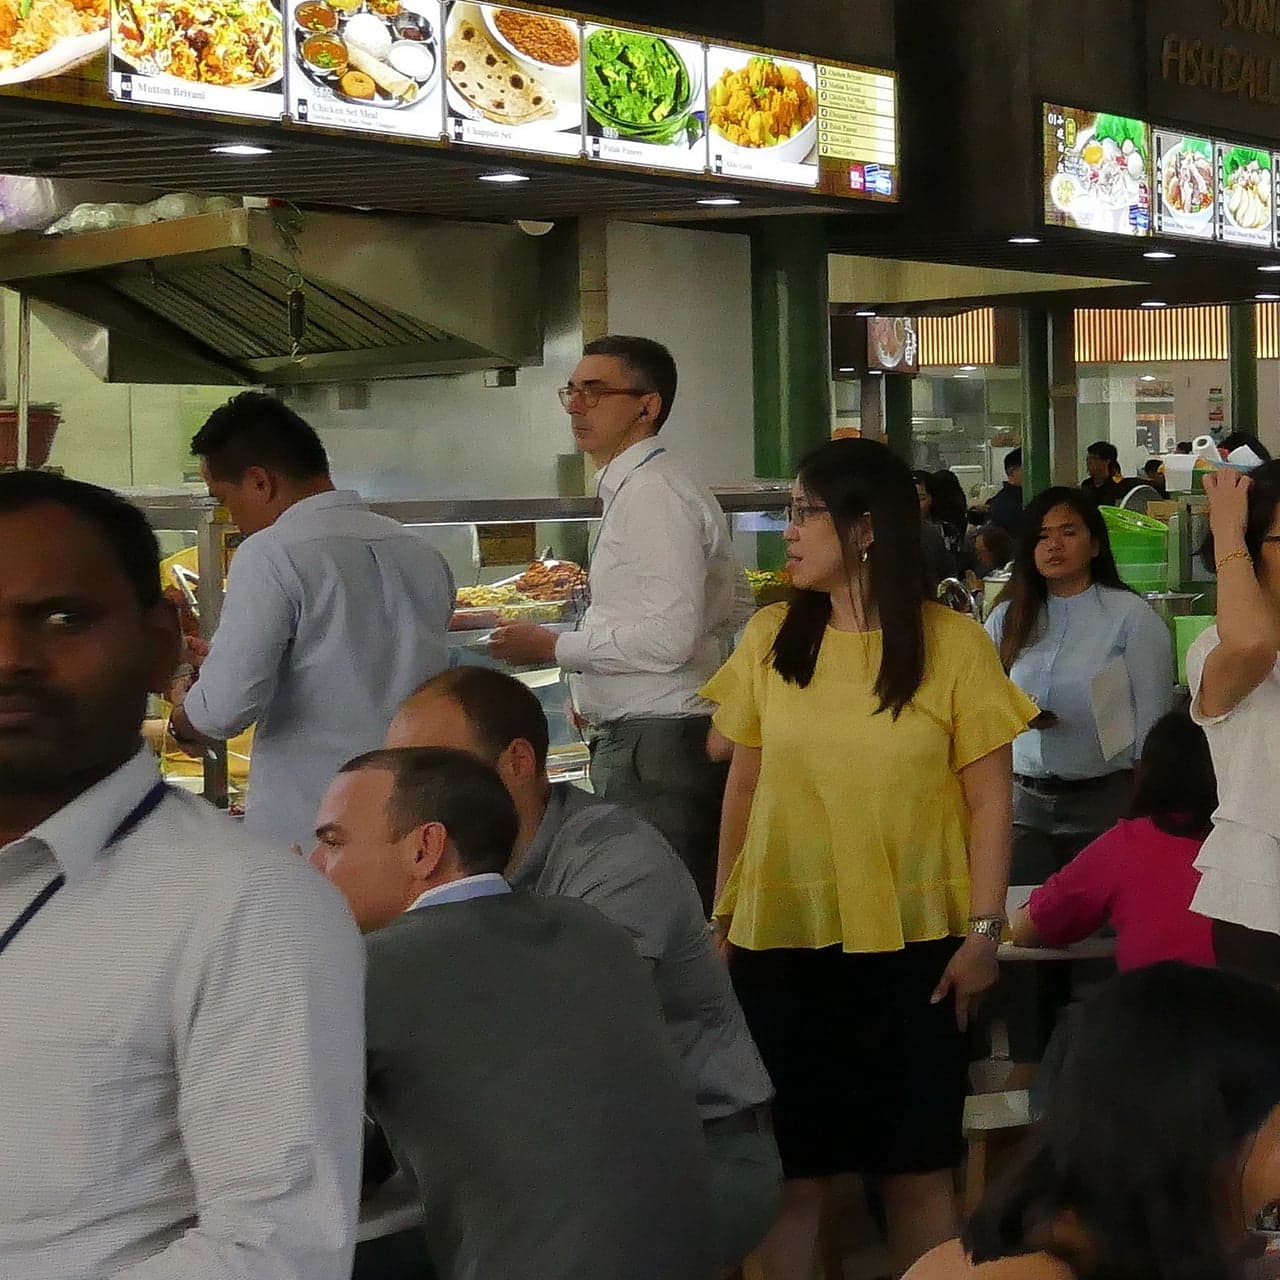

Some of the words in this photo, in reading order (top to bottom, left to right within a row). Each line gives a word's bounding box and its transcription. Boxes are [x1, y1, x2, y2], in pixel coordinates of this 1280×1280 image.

[138, 83, 170, 97] Mutton
[173, 87, 206, 100] Briyani
[312, 103, 345, 116] Chicken
[346, 108, 358, 117] Set
[360, 110, 378, 119] Meal
